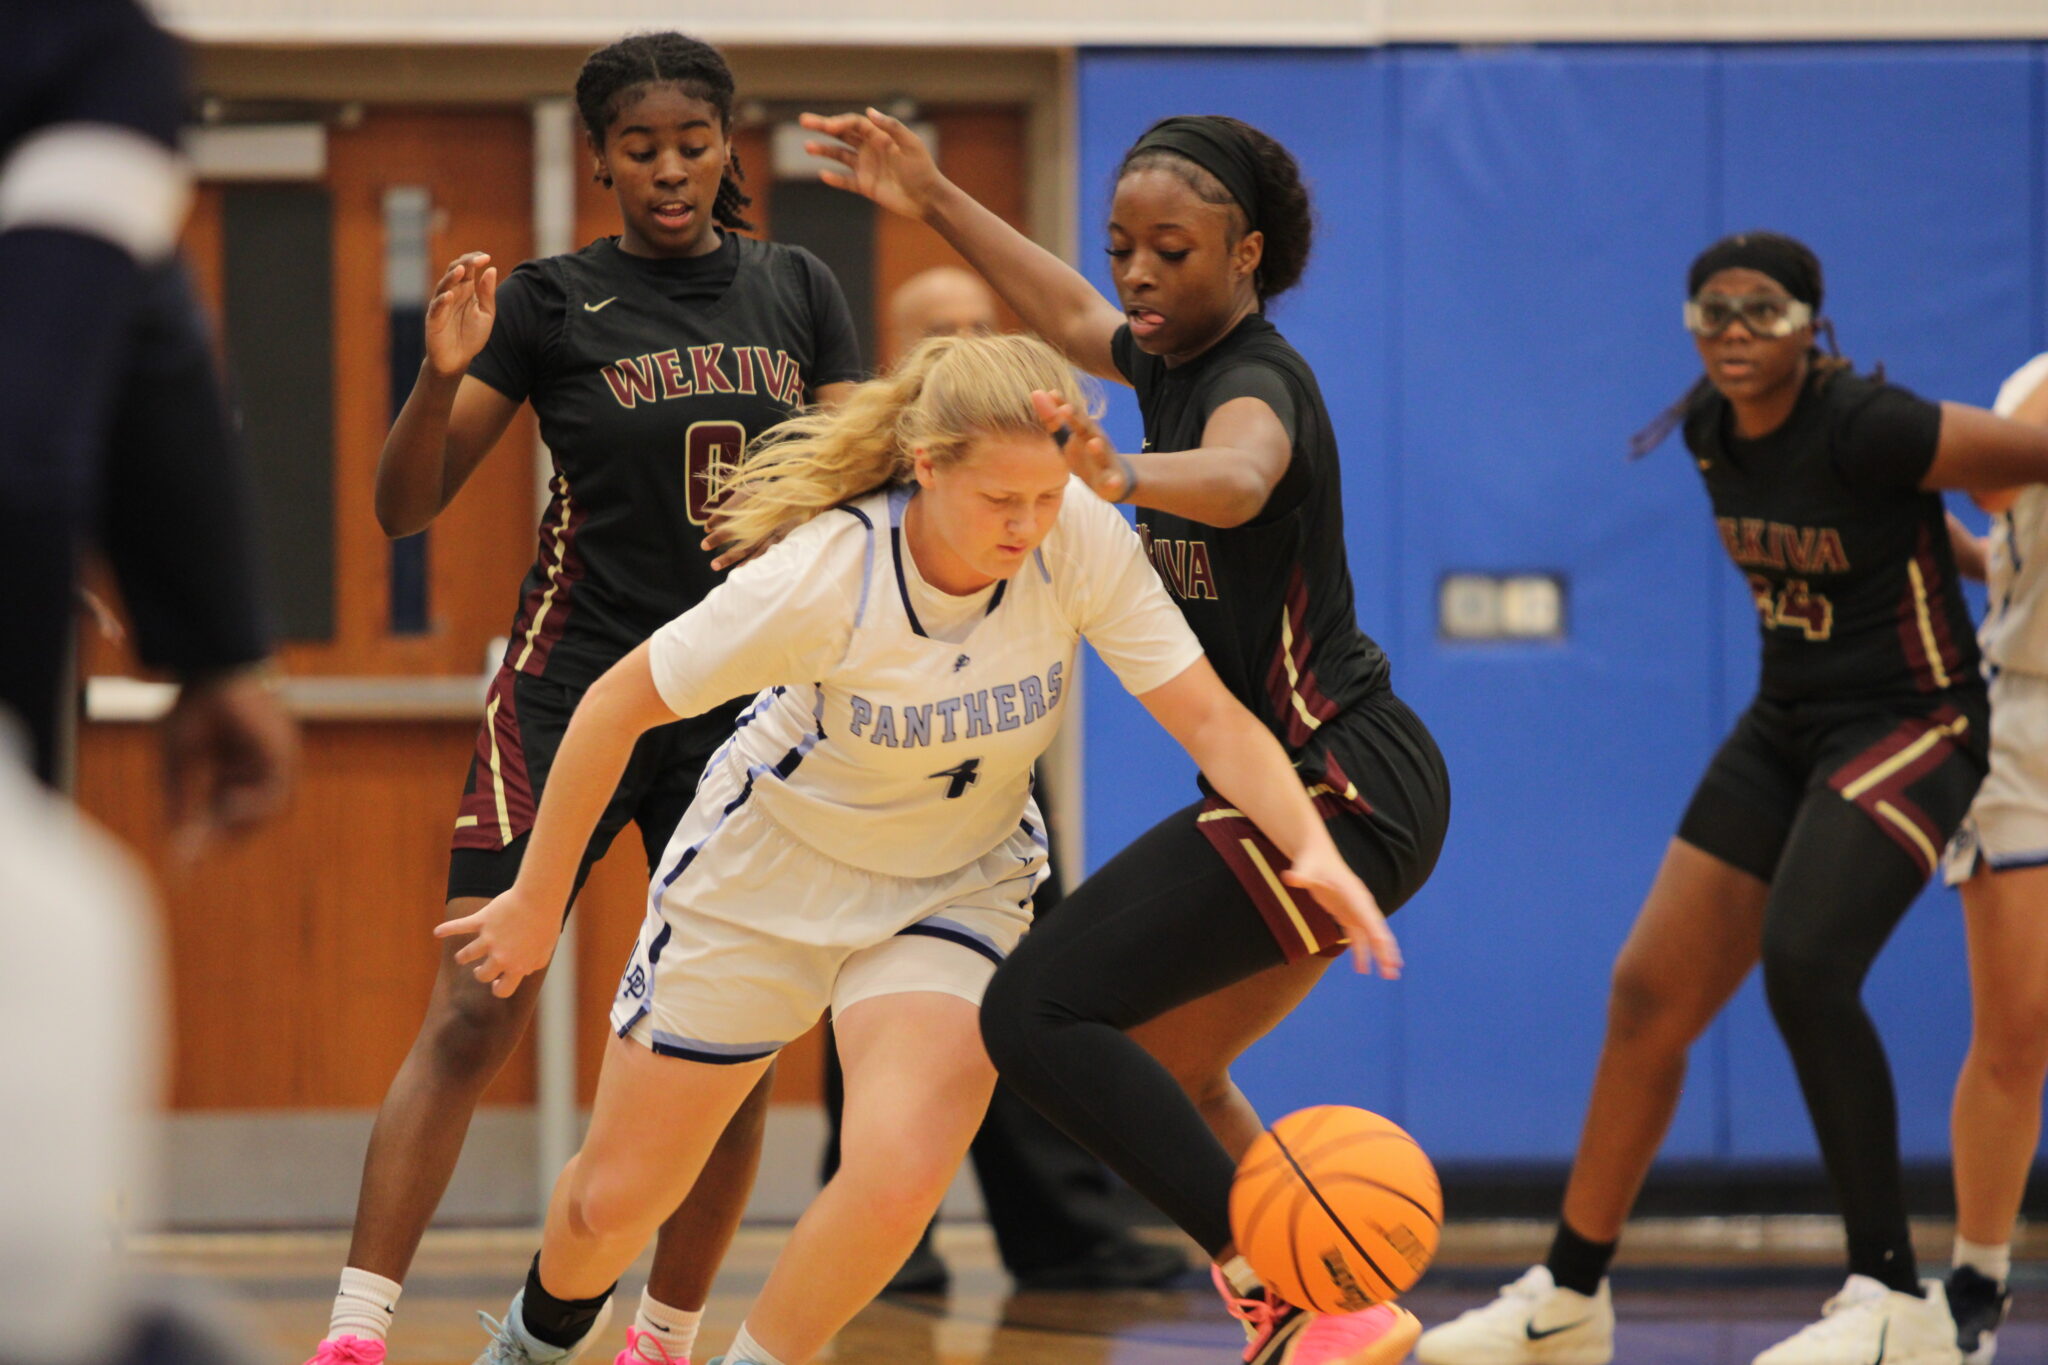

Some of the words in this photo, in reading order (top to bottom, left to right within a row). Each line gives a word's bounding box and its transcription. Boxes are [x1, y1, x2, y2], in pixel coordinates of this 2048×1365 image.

[600, 343, 805, 410] WEKIVA
[685, 420, 747, 527] 0
[849, 661, 1063, 749] PANTHERS
[925, 756, 985, 800] 4
